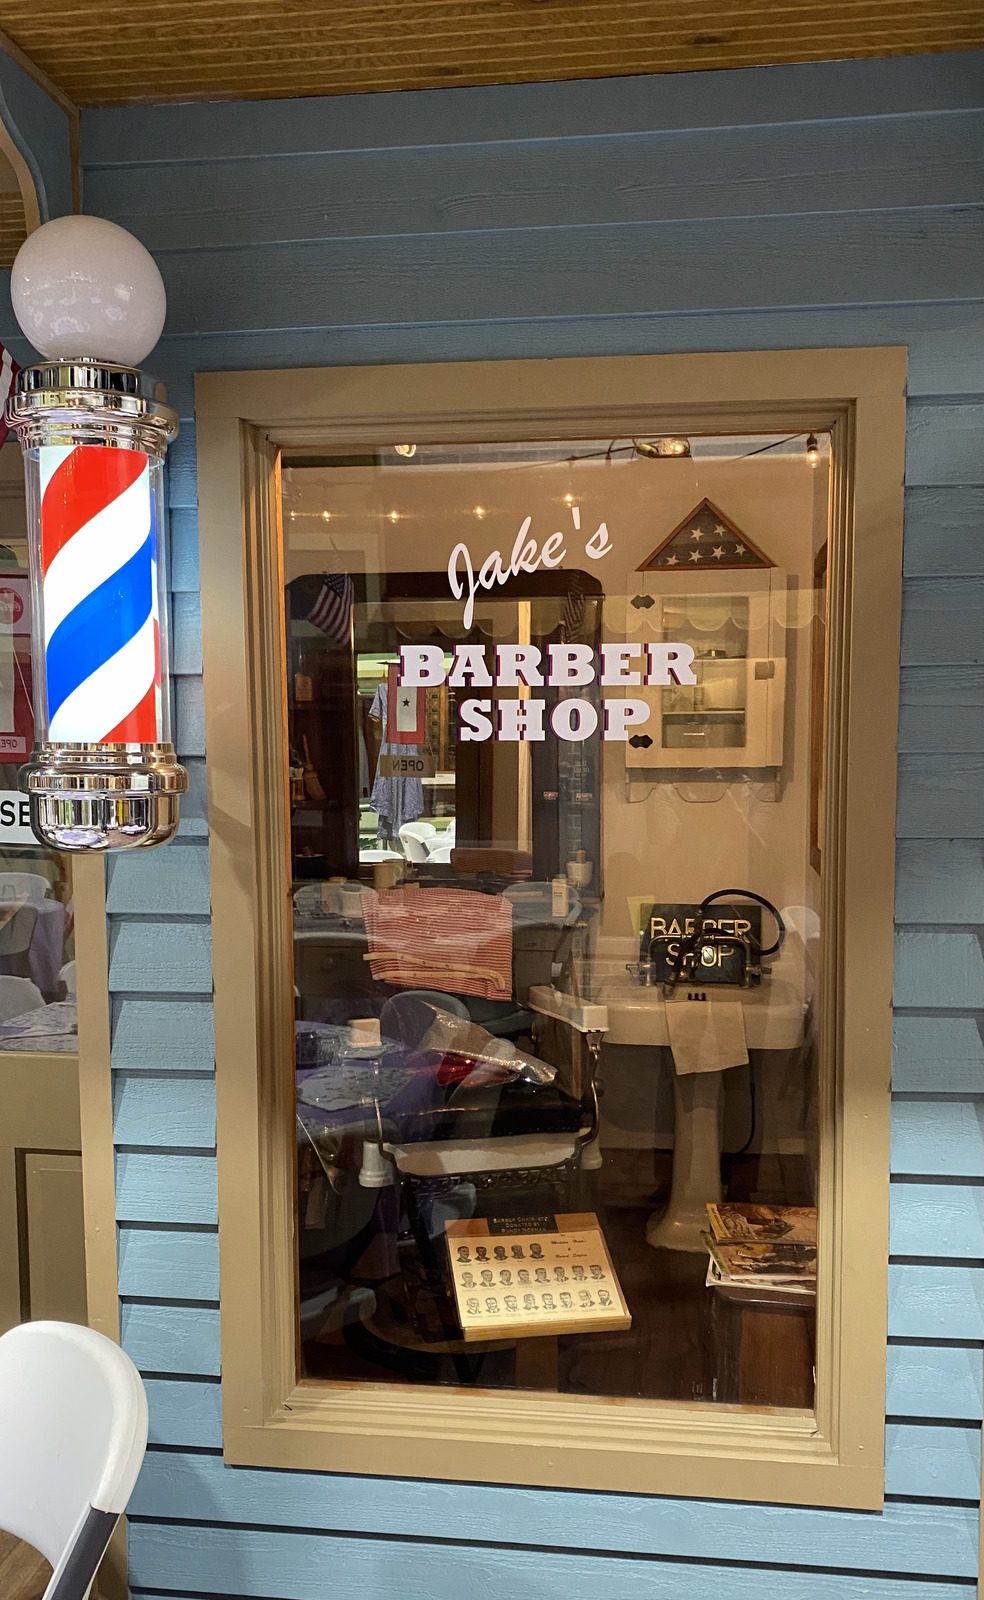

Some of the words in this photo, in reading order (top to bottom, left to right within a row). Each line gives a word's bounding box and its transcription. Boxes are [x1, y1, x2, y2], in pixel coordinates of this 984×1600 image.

[448, 506, 613, 630] Jake's
[397, 642, 697, 687] BARBER
[457, 698, 651, 742] SHOP
